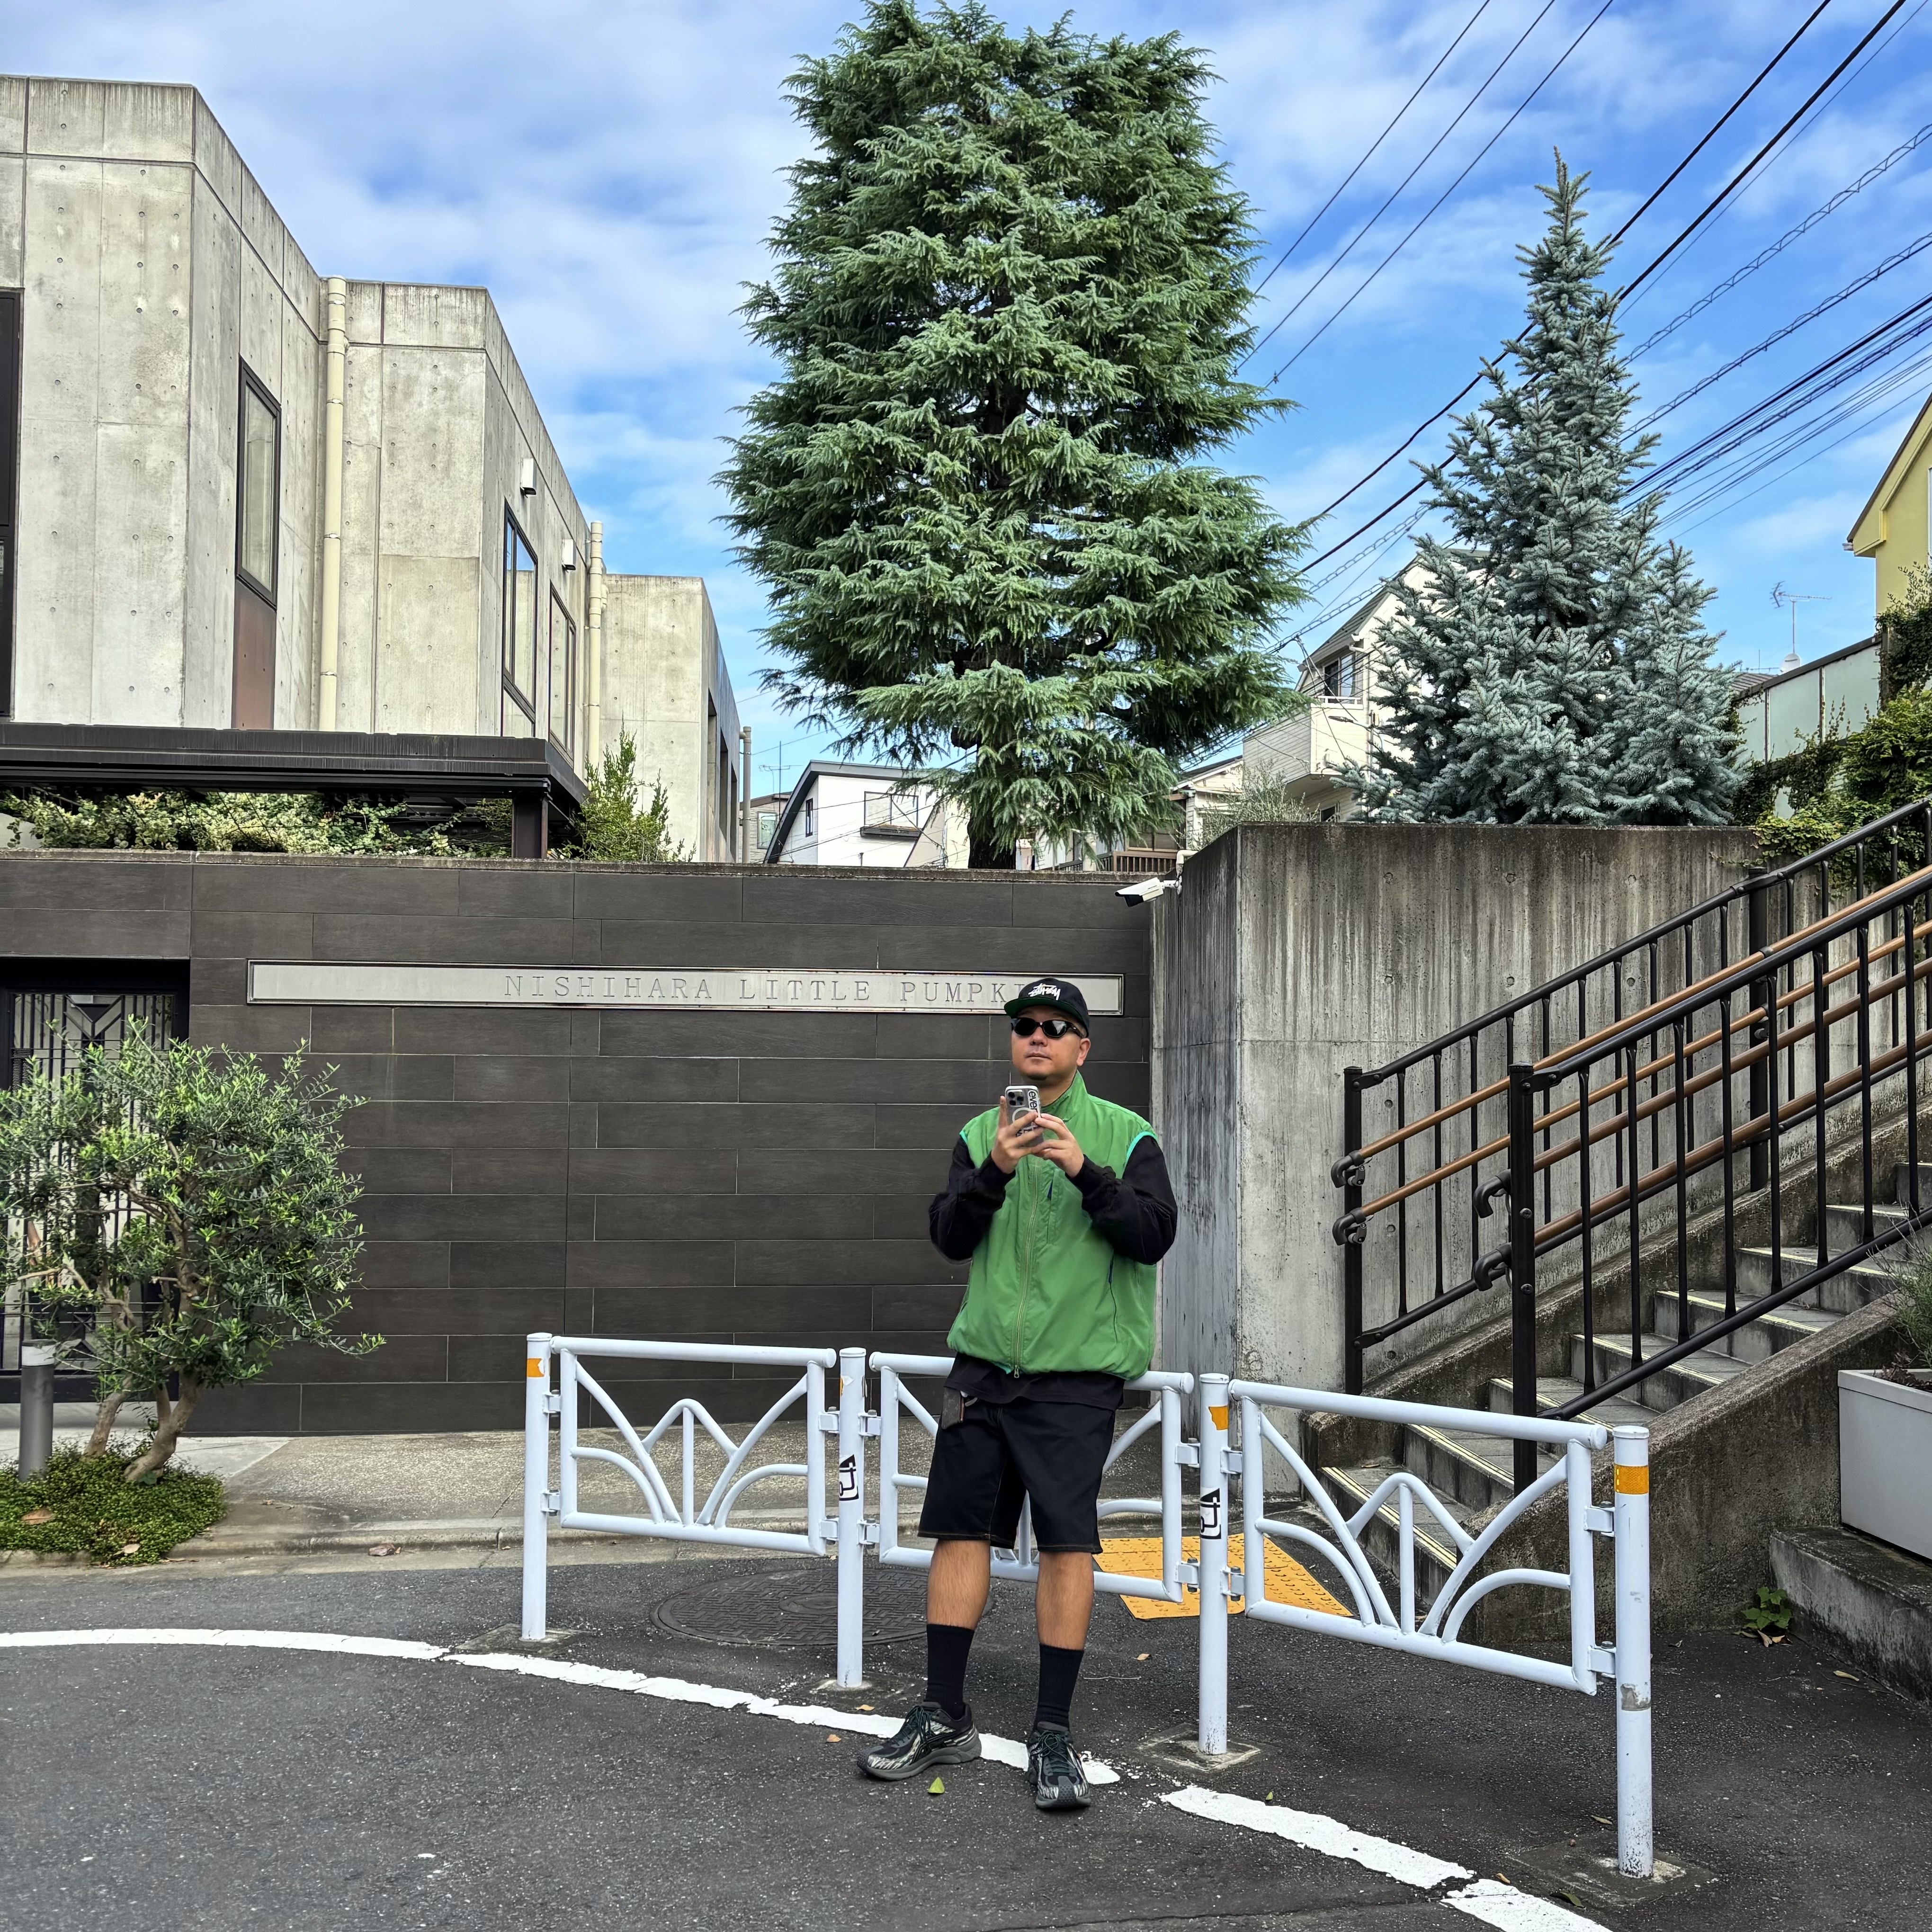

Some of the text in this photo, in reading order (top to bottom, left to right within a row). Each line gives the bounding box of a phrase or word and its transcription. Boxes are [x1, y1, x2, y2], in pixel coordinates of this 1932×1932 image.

[504, 976, 712, 998] NISHIHARA
[739, 979, 870, 1001] LITTLE
[1029, 1091, 1038, 1114] ever
